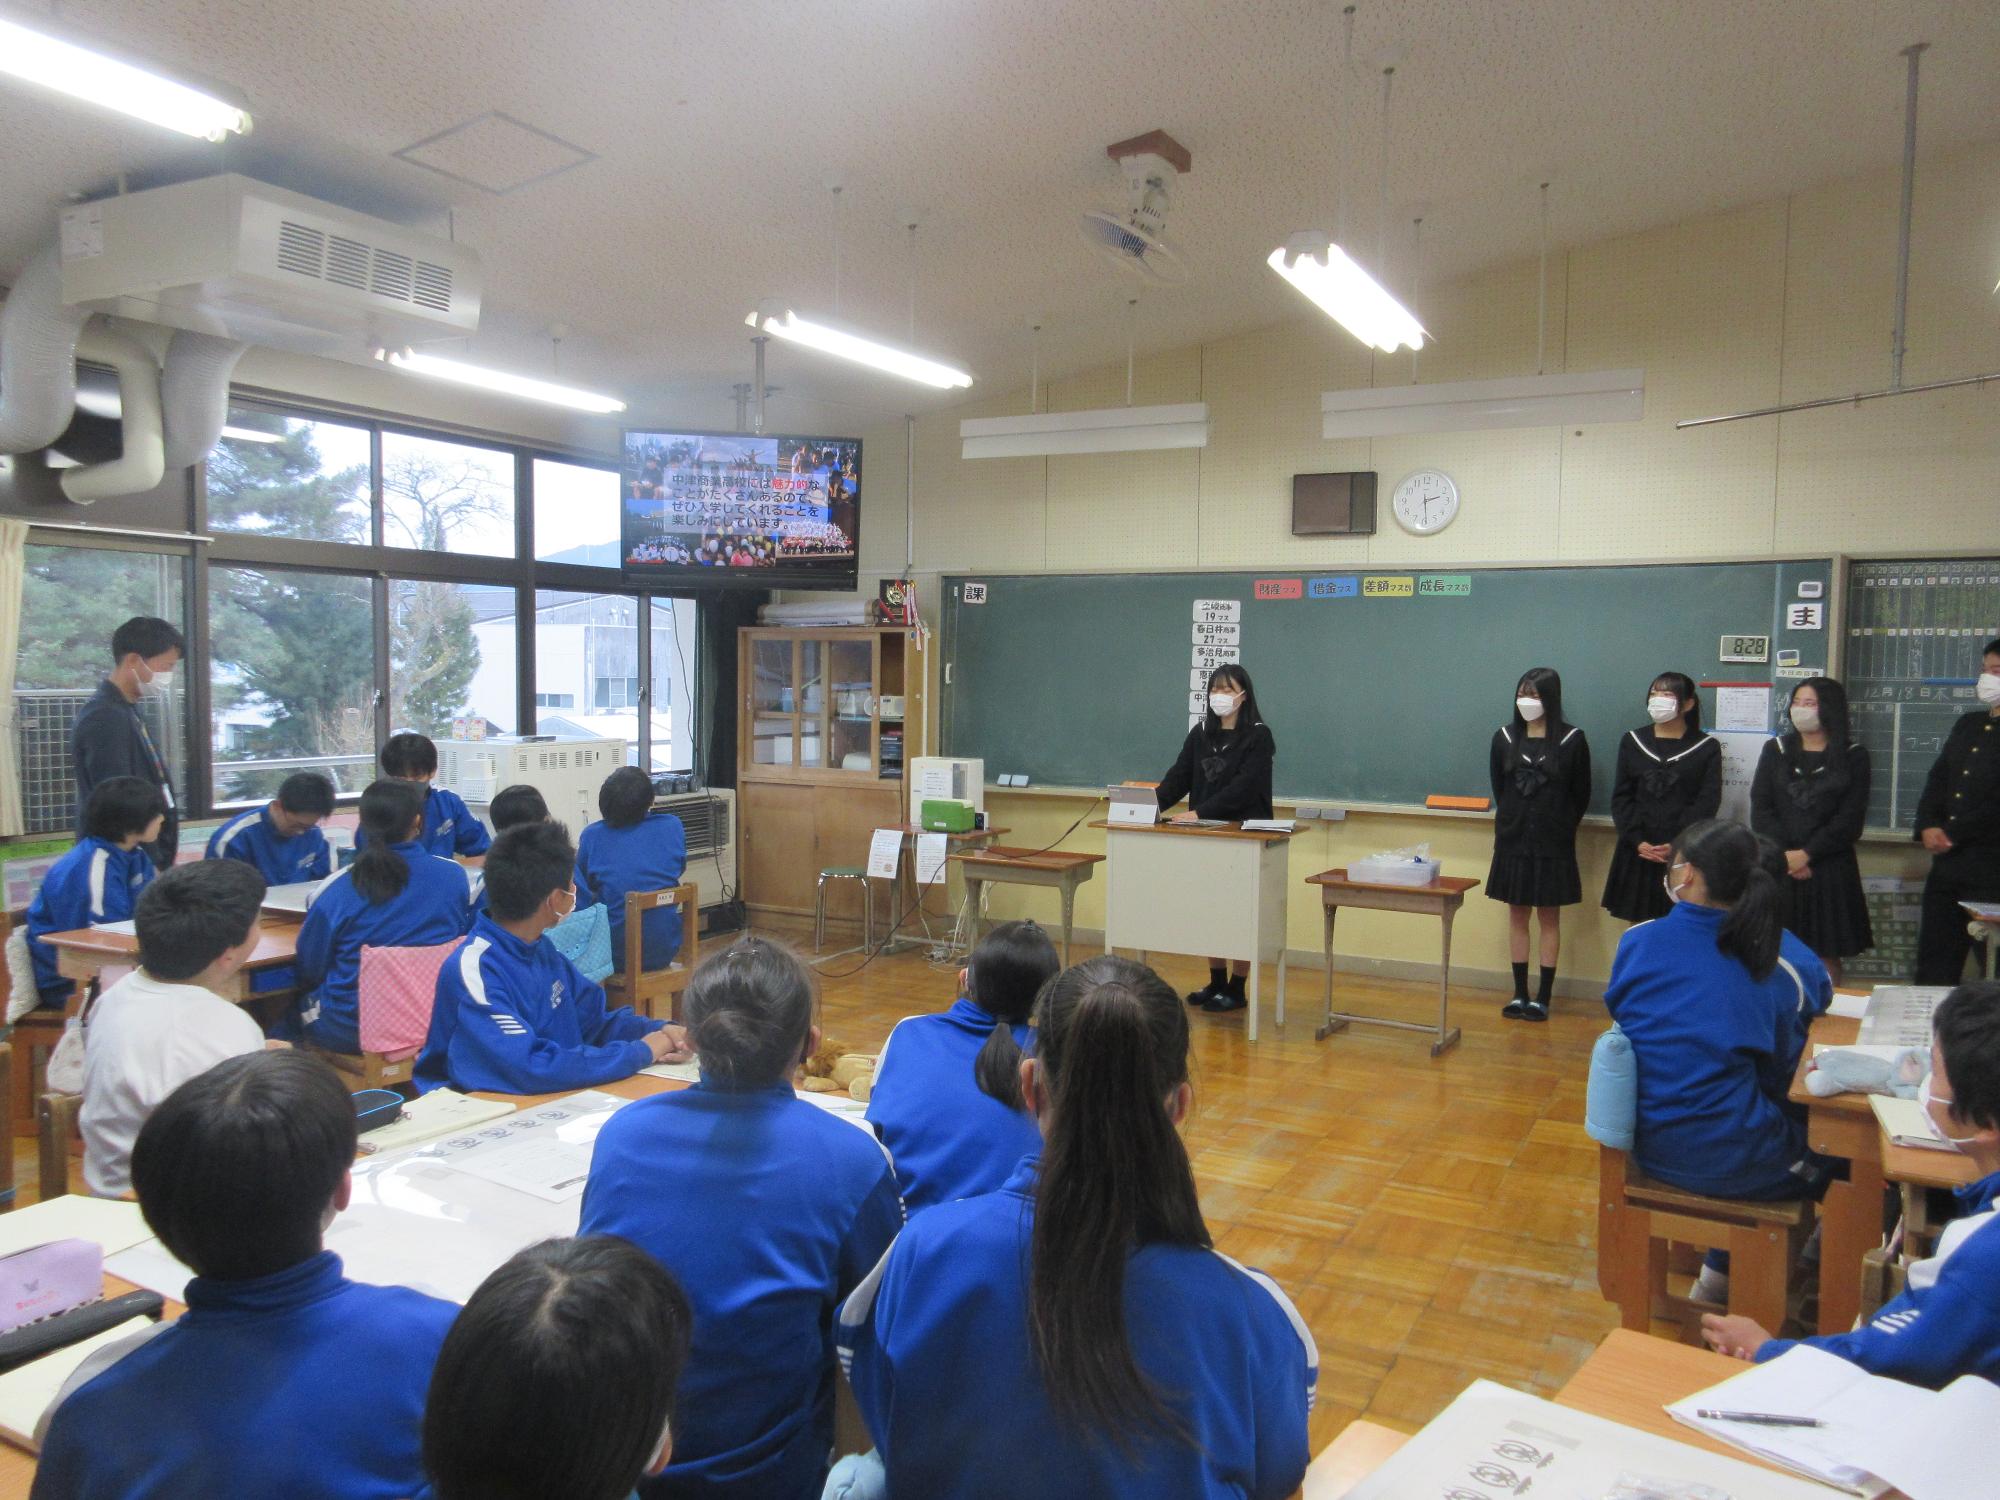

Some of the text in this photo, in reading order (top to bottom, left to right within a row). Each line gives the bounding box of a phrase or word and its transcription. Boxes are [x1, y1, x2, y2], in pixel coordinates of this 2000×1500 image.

[671, 475, 820, 491] 中津商業高校には魅力的な
[671, 488, 815, 505] ことがたくさんあるので、
[671, 501, 820, 518] ぜひ入学してくれることを
[671, 515, 790, 530] 楽しみにしています。
[965, 586, 985, 601] 課
[1791, 606, 1817, 626] ま
